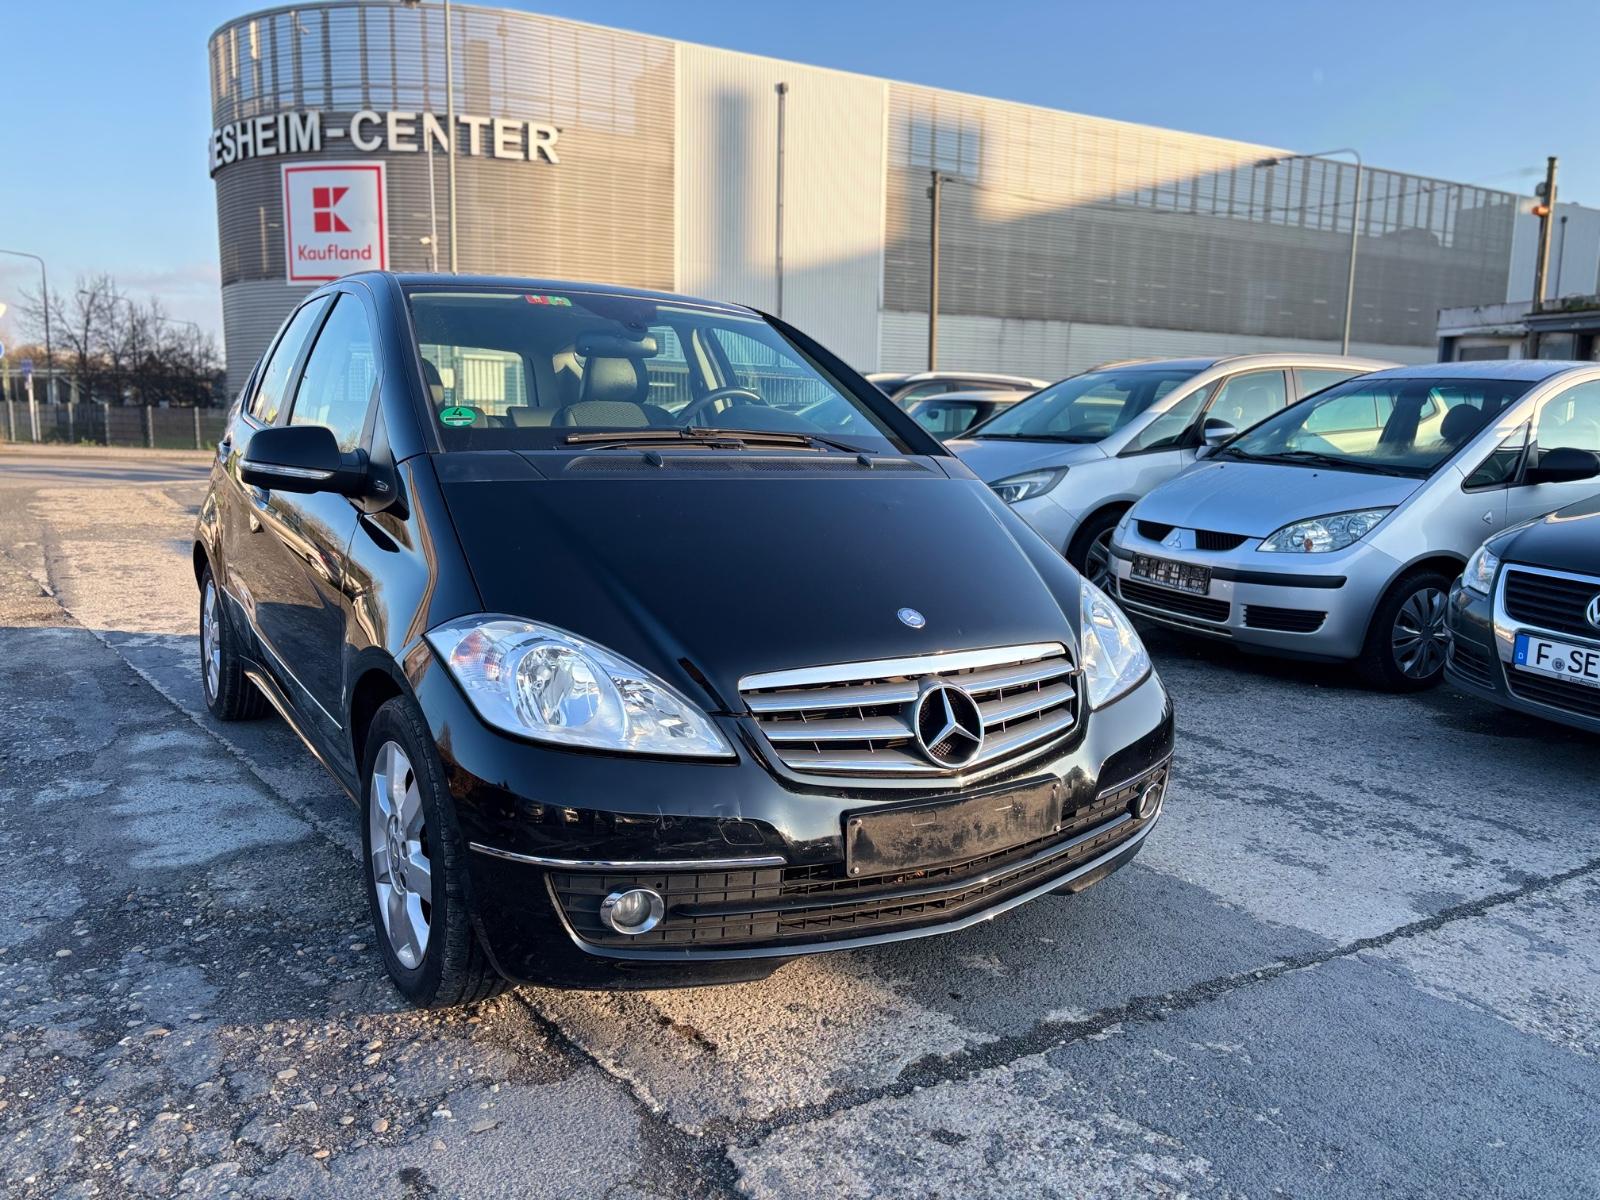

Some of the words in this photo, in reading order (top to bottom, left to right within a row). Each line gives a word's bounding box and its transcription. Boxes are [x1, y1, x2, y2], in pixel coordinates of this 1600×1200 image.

[209, 110, 560, 172] ESHEIM-CENTER
[298, 244, 371, 260] Kaufland
[453, 408, 463, 416] 4
[1536, 643, 1552, 665] F
[1567, 650, 1600, 678] SE
